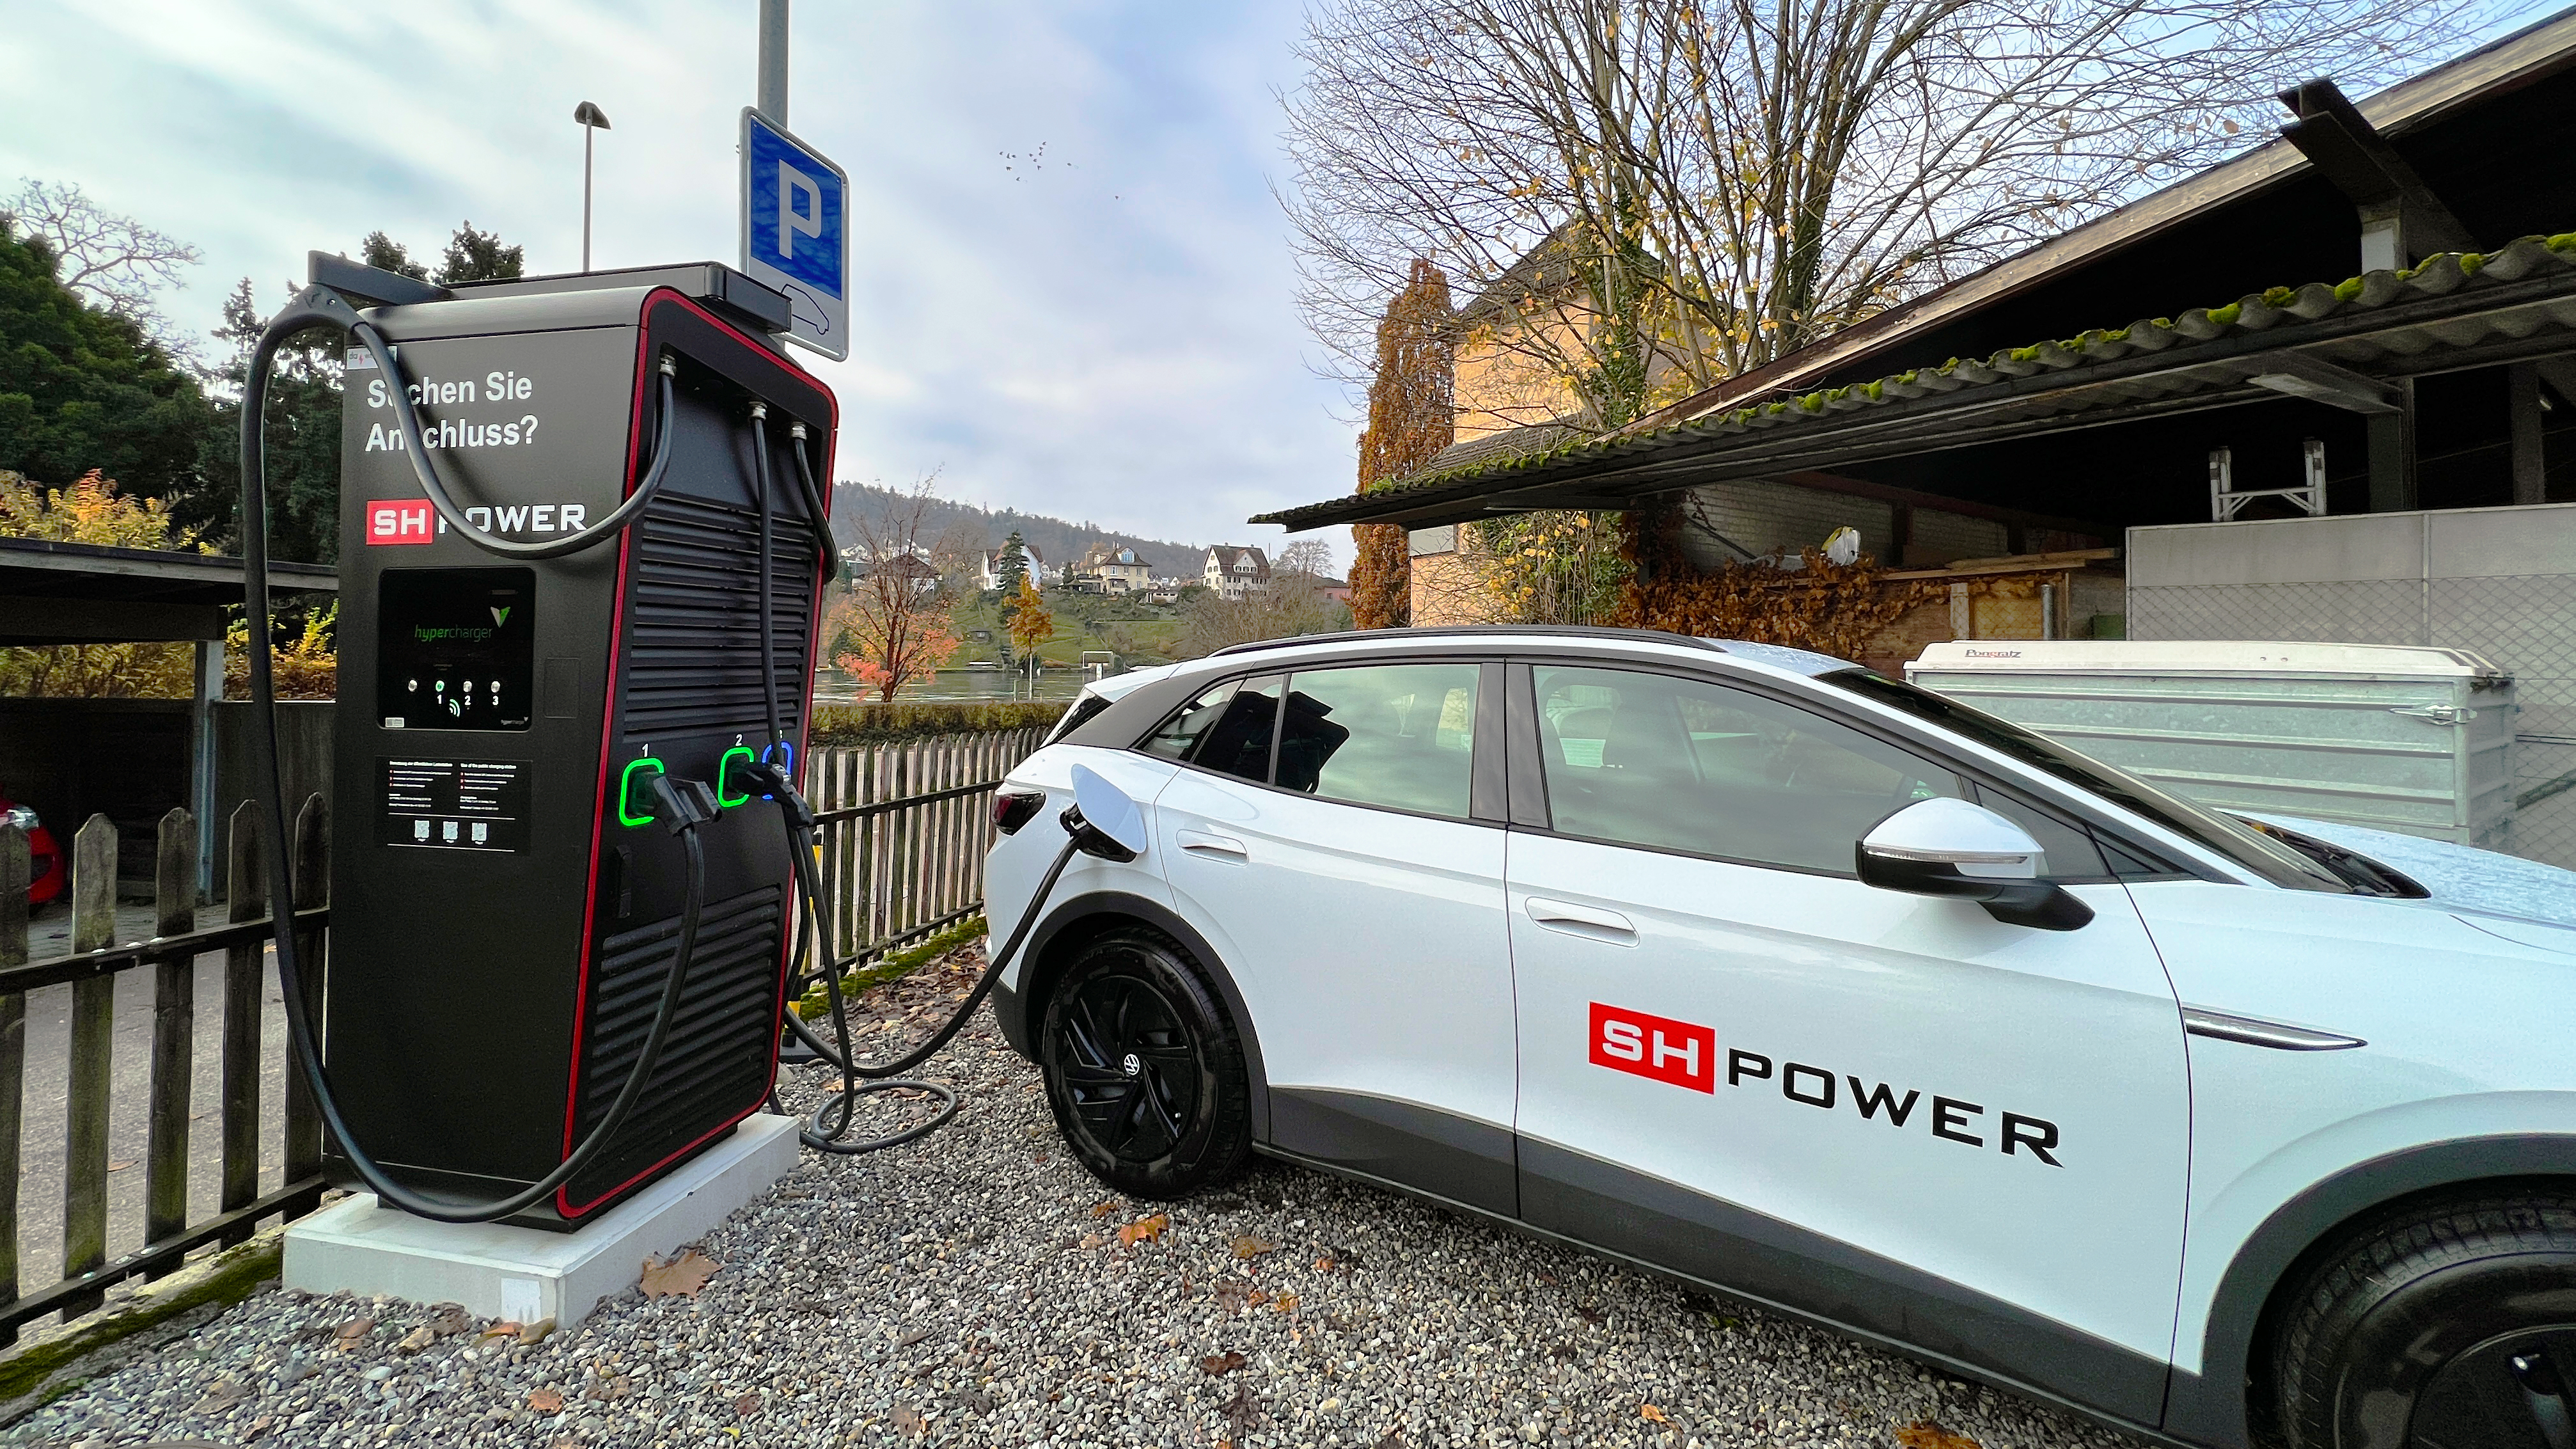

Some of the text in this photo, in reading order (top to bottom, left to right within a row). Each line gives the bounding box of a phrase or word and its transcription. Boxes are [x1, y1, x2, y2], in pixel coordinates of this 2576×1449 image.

[778, 159, 822, 260] P
[367, 371, 533, 408] Schen Sie
[365, 415, 538, 452] Anchluss?
[373, 508, 426, 535] SH
[414, 624, 493, 642] hypercharger
[1965, 649, 2022, 658] Pongratz
[437, 694, 499, 706] 1 2 3
[642, 743, 649, 757] 1
[735, 734, 742, 747] 2
[1602, 1018, 2064, 1169] SH POWER
